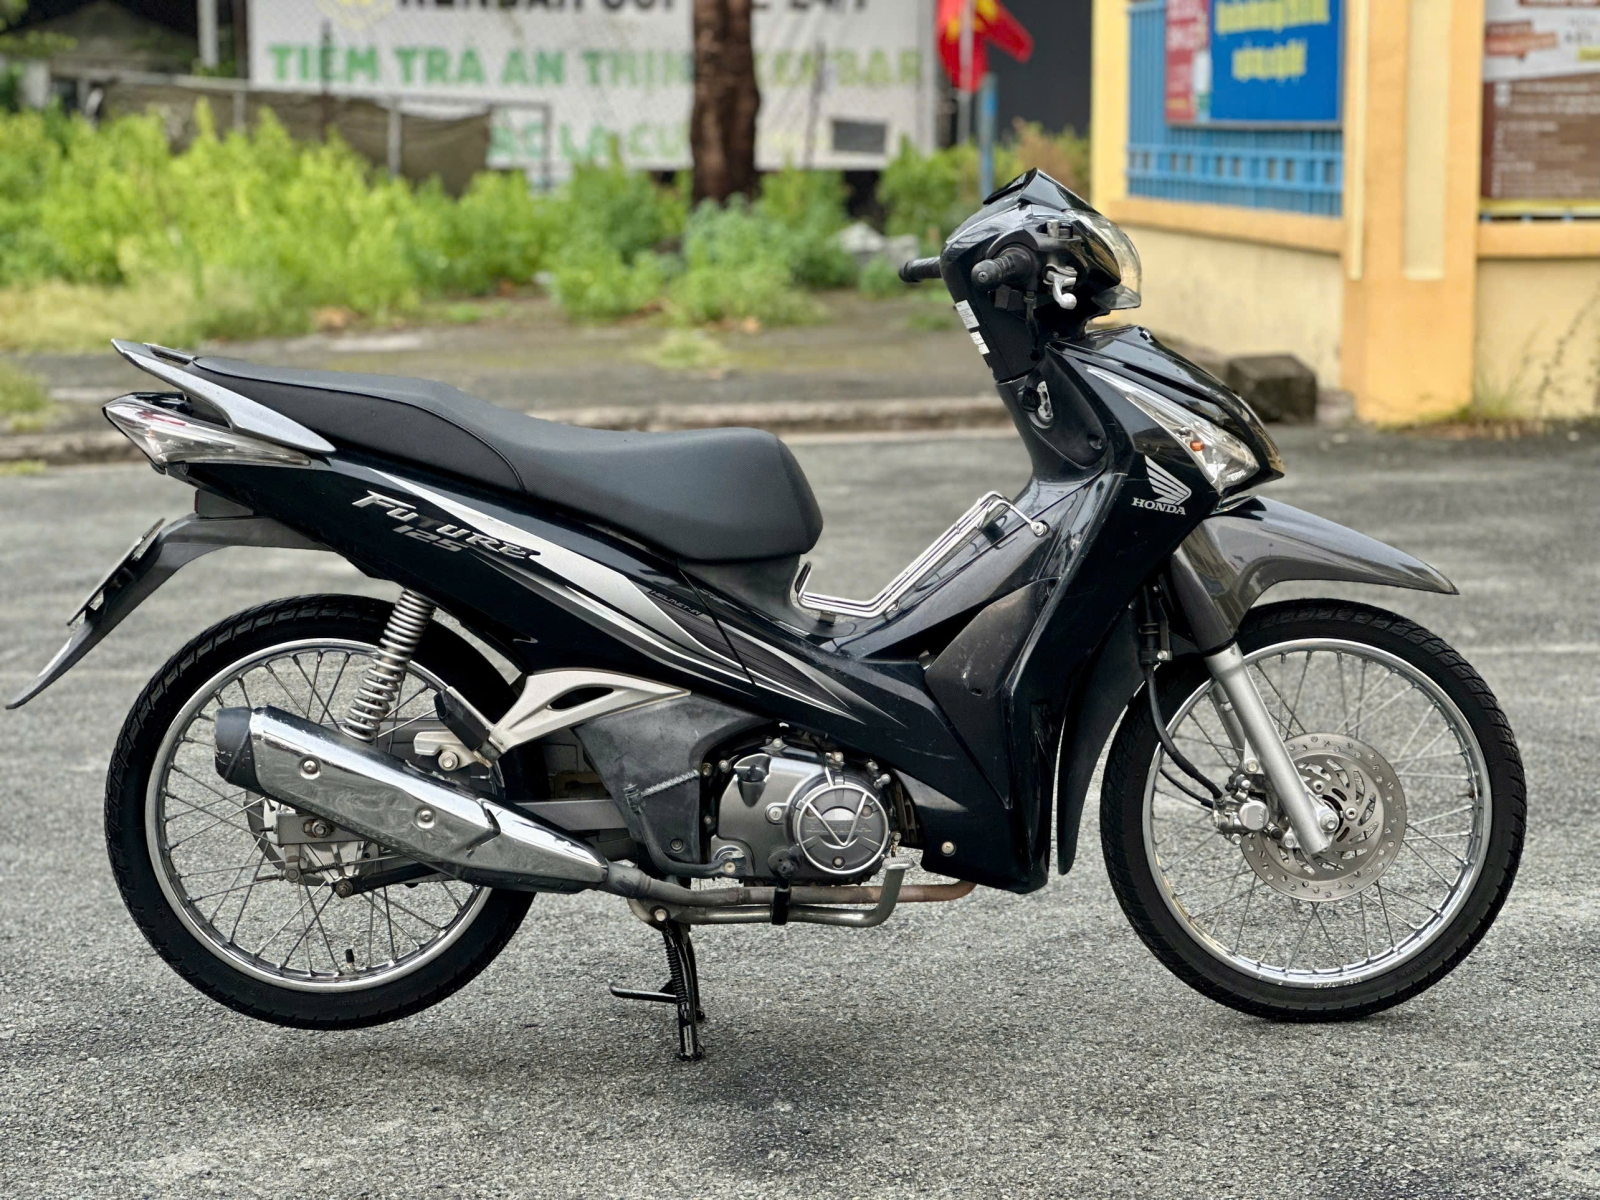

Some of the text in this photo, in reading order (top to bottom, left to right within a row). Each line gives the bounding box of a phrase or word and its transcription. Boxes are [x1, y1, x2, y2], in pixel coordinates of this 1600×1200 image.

[1131, 497, 1186, 515] HONDA
[352, 490, 540, 559] FUTURE
[393, 525, 467, 552] 125
[650, 590, 701, 615] HELMET-IN
